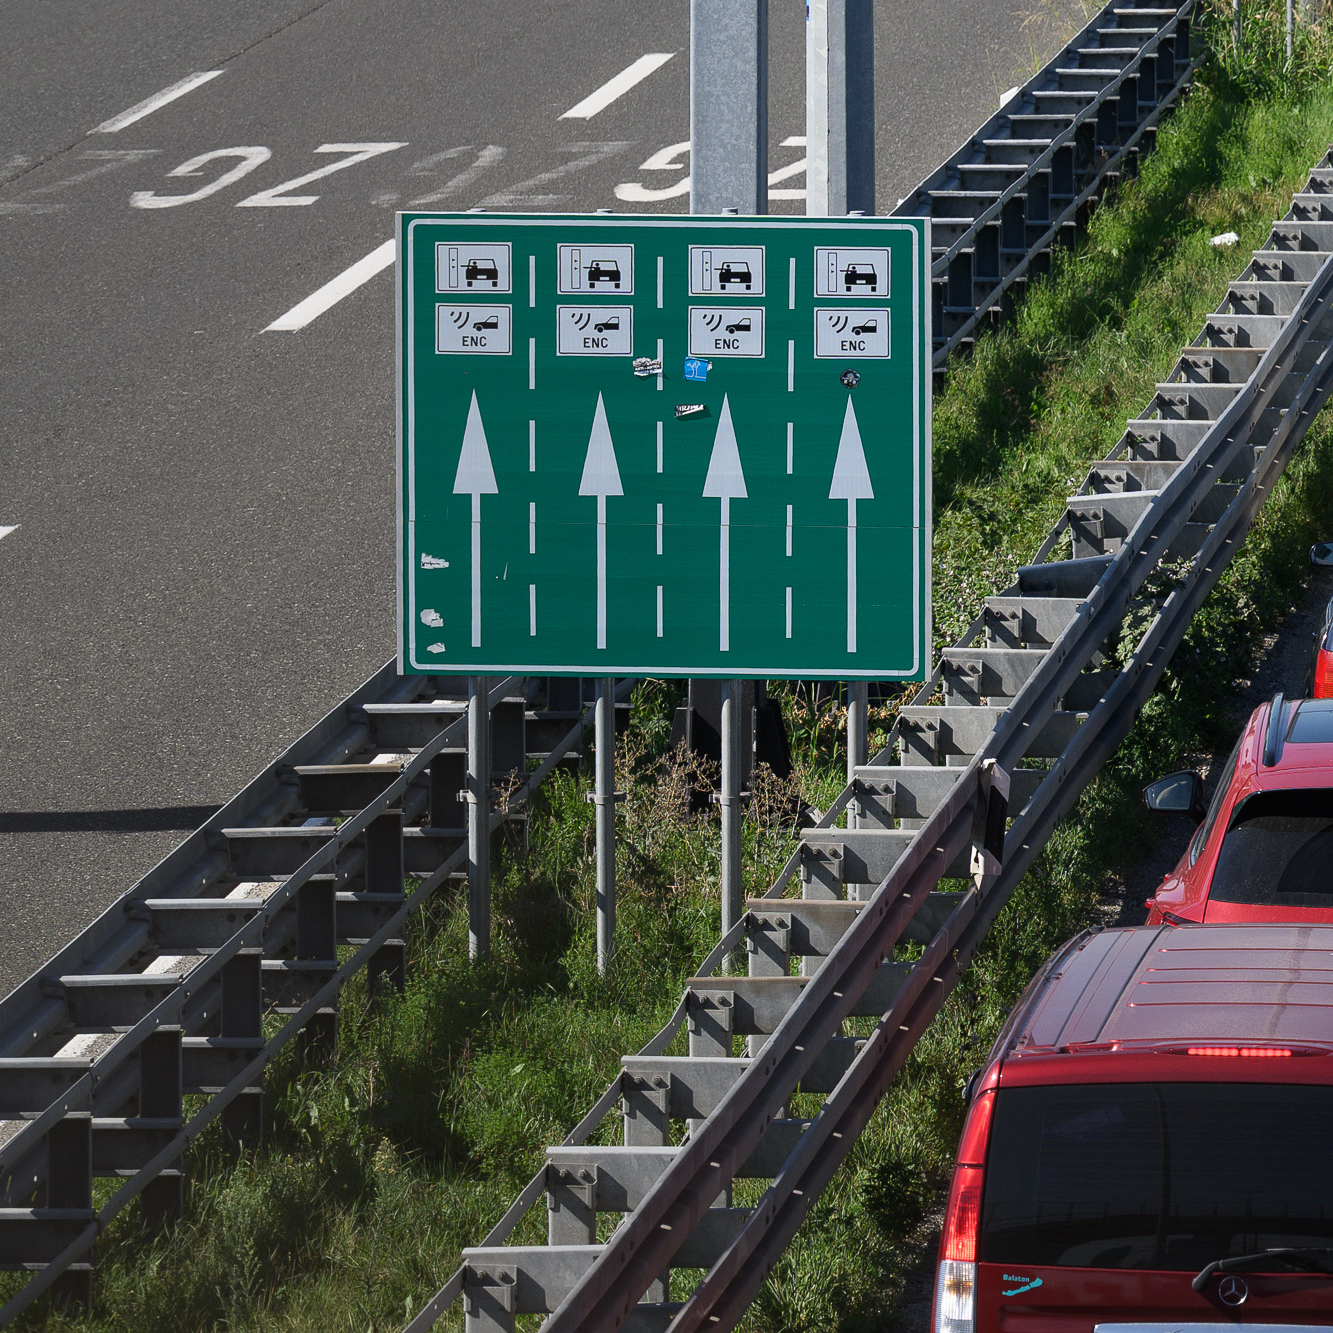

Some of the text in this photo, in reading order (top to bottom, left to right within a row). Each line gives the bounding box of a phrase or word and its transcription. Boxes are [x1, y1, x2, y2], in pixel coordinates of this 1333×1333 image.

[462, 336, 488, 347] ENC
[583, 337, 609, 348] ENC
[714, 339, 740, 350] ENC
[840, 340, 866, 351] ENC
[1003, 1274, 1030, 1283] Balaton
